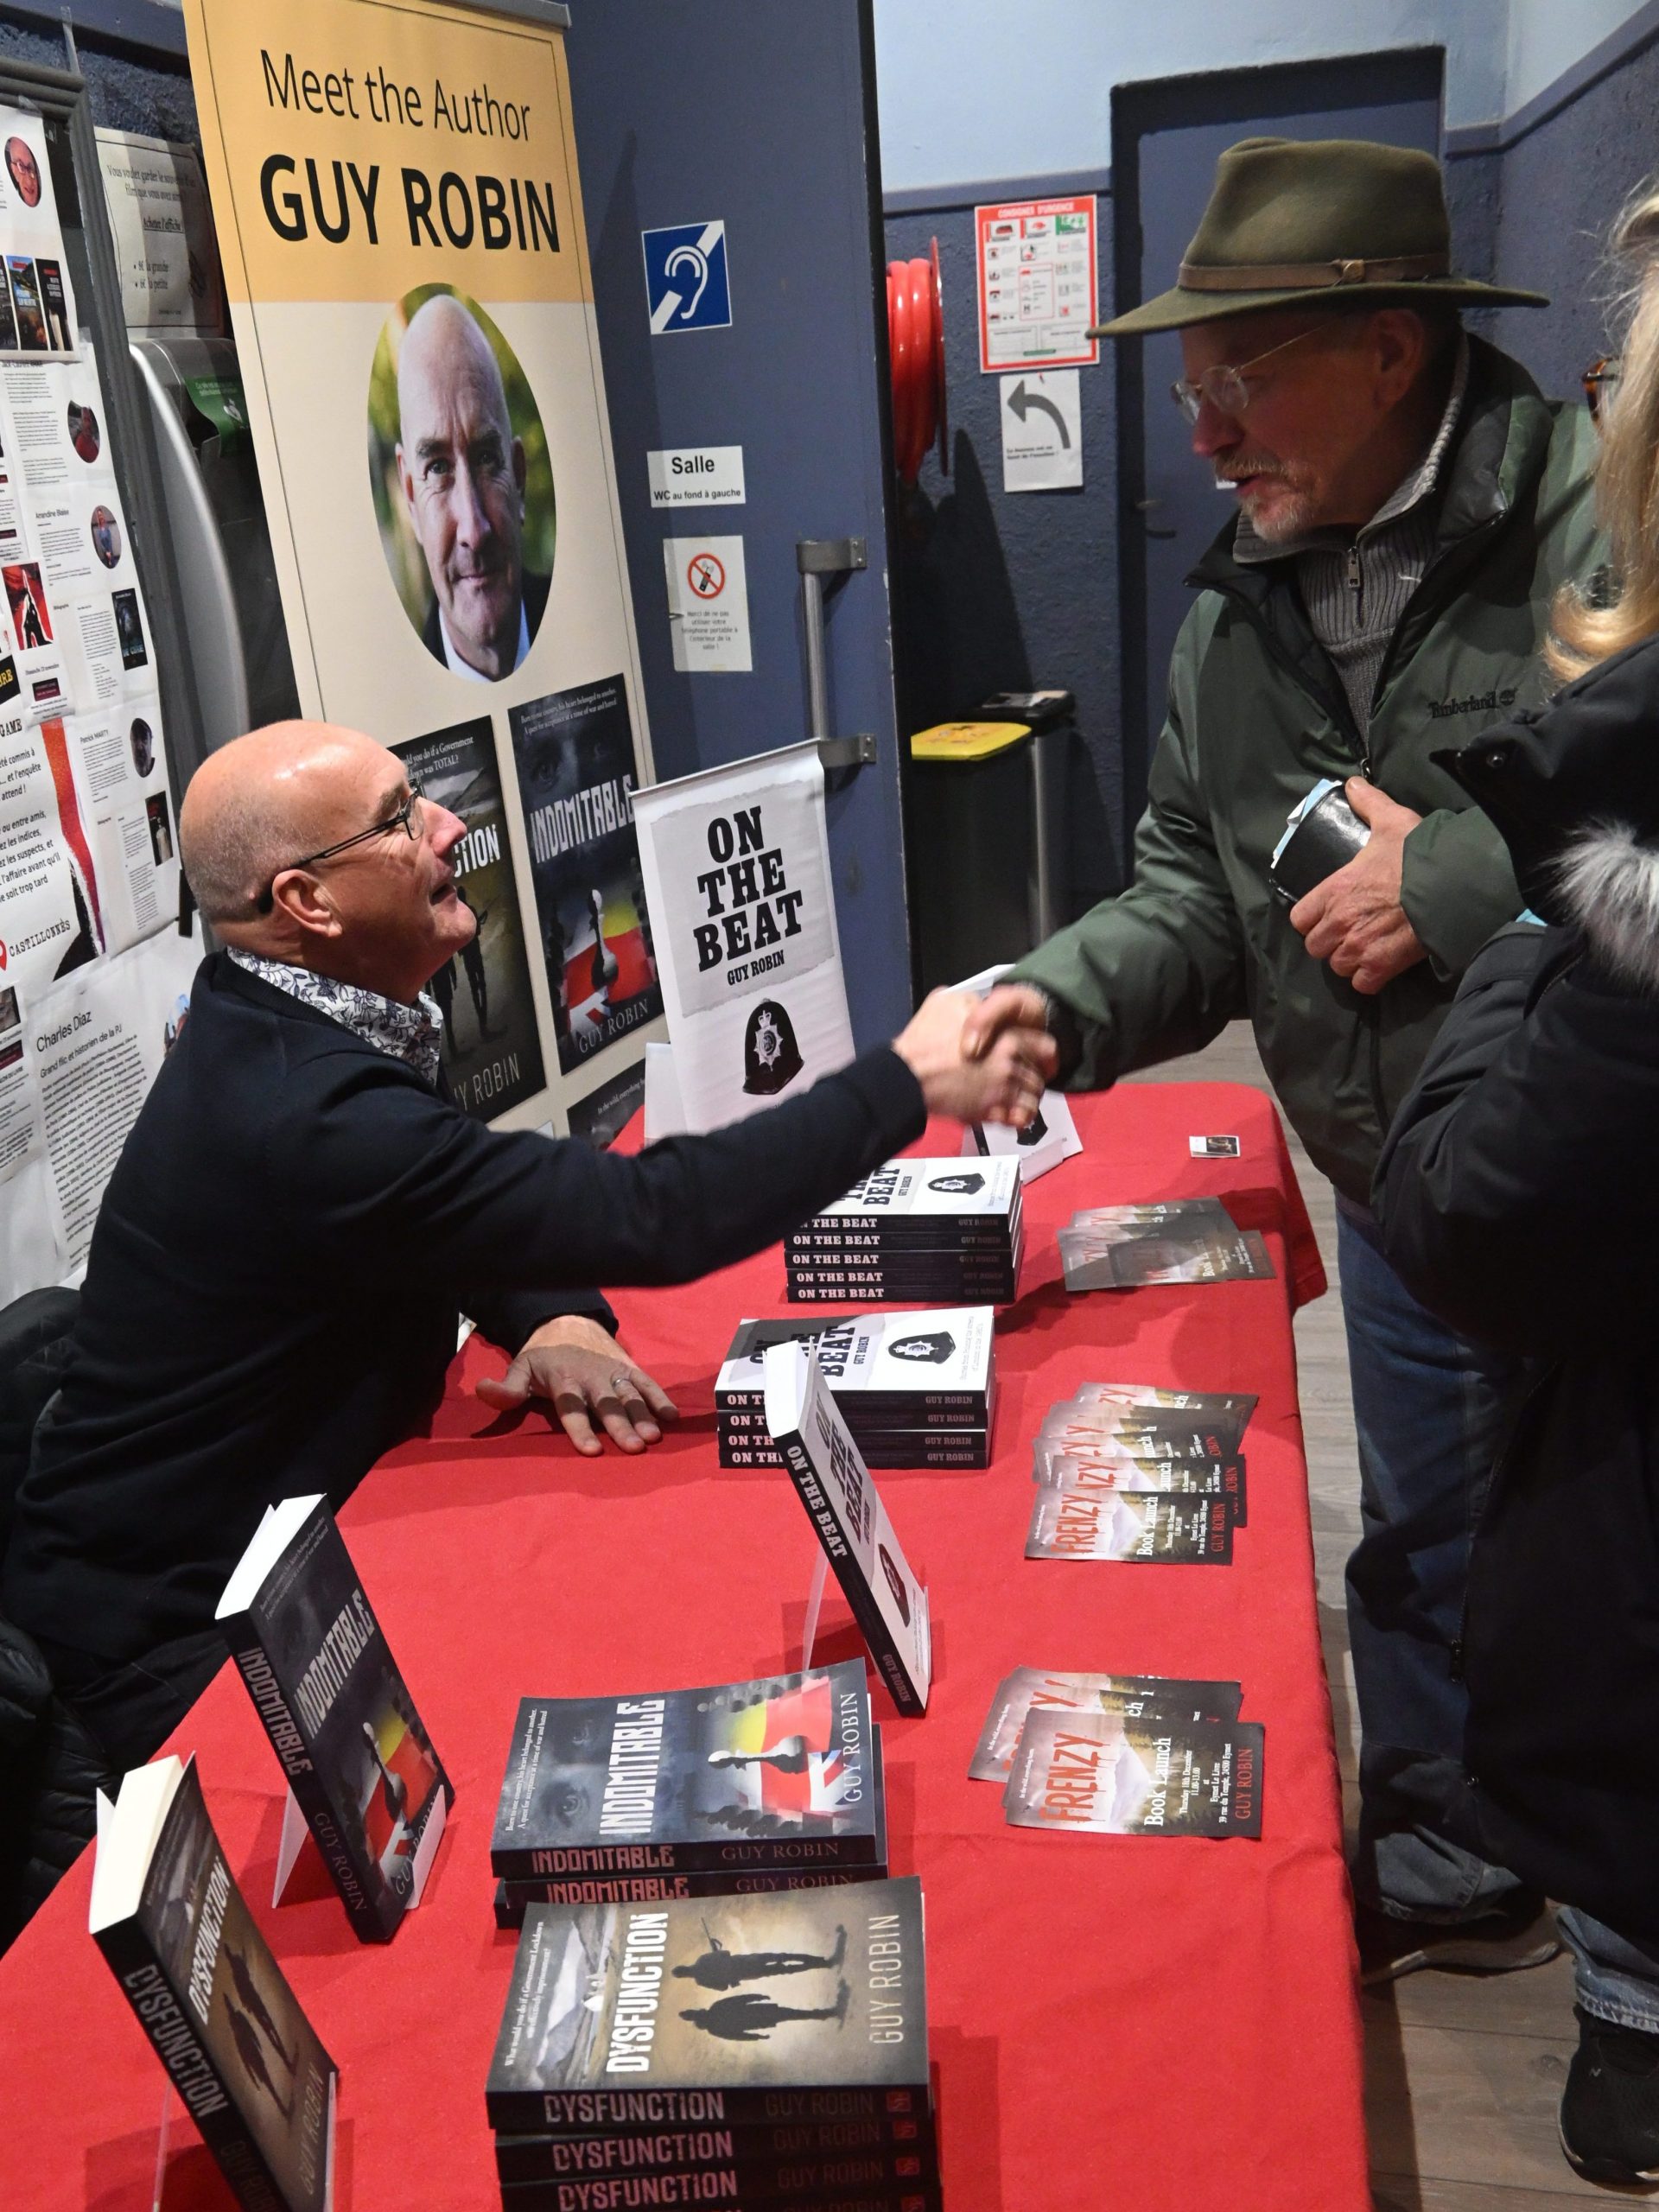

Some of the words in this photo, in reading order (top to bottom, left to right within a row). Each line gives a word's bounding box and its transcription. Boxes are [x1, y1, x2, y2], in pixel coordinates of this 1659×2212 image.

[261, 49, 359, 119] Meet
[365, 66, 423, 127] the
[434, 79, 531, 142] Author
[260, 154, 380, 245] GUY
[401, 167, 561, 253] ROBIN
[671, 455, 715, 475] Salle
[654, 490, 671, 500] WC
[684, 489, 702, 499] fond
[704, 489, 709, 499] à
[711, 489, 741, 500] gauche
[9, 749, 30, 766] commis
[31, 747, 35, 756] à
[7, 772, 15, 783] et
[15, 763, 41, 779] l'enquête
[1, 785, 22, 800] attend
[3, 823, 11, 833] ou
[12, 817, 29, 830] entre
[29, 810, 47, 823] amis,
[530, 774, 635, 864] INDOMITABLE
[7, 836, 17, 849] les
[17, 828, 41, 845] indices,
[707, 805, 765, 863] ON
[6, 854, 16, 864] les
[16, 844, 46, 865] suspects,
[46, 839, 54, 850] et
[2, 868, 28, 885] l'affaire
[28, 860, 47, 874] avant
[46, 851, 60, 867] qu'il
[6, 887, 19, 901] soit
[19, 883, 34, 896] trop
[34, 874, 48, 888] tard
[696, 848, 787, 918] THE
[9, 918, 71, 958] CASTILLONNÈS
[693, 889, 804, 973] BEAT
[727, 961, 750, 986] GUY
[750, 950, 785, 979] ROBIN
[36, 1022, 73, 1052] Charles
[73, 1011, 92, 1031] Diaz
[579, 1024, 603, 1053] GUY
[607, 998, 648, 1035] ROBIN
[40, 1059, 59, 1078] Grand
[58, 1055, 67, 1067] flic
[67, 1052, 74, 1062] et
[74, 1037, 99, 1059] historien
[99, 1032, 109, 1043] de
[108, 1027, 115, 1039] la
[115, 1024, 123, 1036] PJ
[473, 1052, 520, 1104] ROBIN
[864, 1167, 901, 1205] BEAT
[812, 1218, 838, 1228] THE
[842, 1218, 877, 1228] BEAT
[793, 1236, 810, 1245] ON
[814, 1236, 841, 1245] THE
[845, 1236, 880, 1245] BEAT
[792, 1255, 810, 1264] ON
[813, 1255, 840, 1264] THE
[843, 1255, 879, 1264] BEAT
[797, 1273, 814, 1282] ON
[817, 1273, 844, 1282] THE
[849, 1273, 883, 1282] BEAT
[798, 1289, 816, 1299] ON
[819, 1288, 846, 1299] THE
[849, 1288, 884, 1298] BEAT
[818, 1326, 855, 1376] BEAT
[856, 1336, 870, 1353] ROBIN
[854, 1355, 866, 1364] GUY
[727, 1395, 747, 1405] ON
[925, 1395, 943, 1404] GUY
[944, 1395, 973, 1404] ROBIN
[730, 1415, 750, 1426] ON
[927, 1414, 944, 1423] GUY
[946, 1414, 975, 1422] ROBIN
[728, 1435, 749, 1446] ON
[944, 1436, 972, 1445] ROBIN
[732, 1452, 753, 1463] ON
[944, 1452, 974, 1461] ROBIN
[787, 1446, 808, 1471] ON
[799, 1472, 825, 1510] THE
[816, 1510, 848, 1557] BEAT
[1141, 1497, 1158, 1529] Launch
[1050, 1493, 1105, 1554] FRENZY
[1211, 1503, 1225, 1531] ROBIN
[1136, 1531, 1154, 1556] Book
[1211, 1534, 1224, 1552] GUY
[293, 1589, 375, 1740] INDOMITABLE
[882, 1654, 899, 1672] GUY
[891, 1672, 912, 1702] ROBIN
[238, 1647, 314, 1777] INDOMITABLE
[840, 1692, 859, 1758] ROBIN
[1149, 1738, 1171, 1785] Launch
[1183, 1750, 1192, 1776] December
[1223, 1743, 1232, 1759] Eymet
[600, 1699, 665, 1835] INDOMITABLE
[1039, 1732, 1104, 1823] FRENZY
[1211, 1763, 1220, 1776] Livre
[1222, 1760, 1230, 1775] 24500
[1237, 1749, 1253, 1788] ROBIN
[842, 1766, 861, 1803] GUY
[1182, 1777, 1191, 1788] 18th
[1210, 1786, 1220, 1802] Eymet
[1221, 1776, 1231, 1796] Temple,
[1144, 1790, 1166, 1827] Book
[1179, 1789, 1191, 1814] Thursday
[1220, 1797, 1228, 1806] du
[1235, 1793, 1251, 1820] GUY
[314, 1812, 342, 1849] GUY
[334, 1856, 368, 1911] ROBIN
[531, 1845, 675, 1874] INDOMITABLE
[722, 1846, 766, 1860] GUY
[772, 1842, 839, 1859] ROBIN
[547, 1877, 690, 1904] INDOMITABLE
[736, 1877, 781, 1893] GUY
[787, 1873, 854, 1891] ROBIN
[188, 1857, 231, 2025] DYSFUNCTION
[868, 1915, 902, 1989] ROBIN
[606, 1912, 669, 2074] DYSFUNCTION
[868, 2002, 904, 2044] GUY
[124, 1964, 228, 2118] DYSFUNCTION
[303, 2061, 324, 2143] ROBIN
[544, 2092, 724, 2123] DYSFUNCTION
[766, 2093, 809, 2116] GUY
[812, 2092, 874, 2115] ROBIN
[553, 2131, 733, 2171] DYSFUNCTION
[779, 2164, 820, 2189] GUY
[823, 2160, 884, 2184] ROBIN
[557, 2170, 738, 2212] DYSFUNCTION
